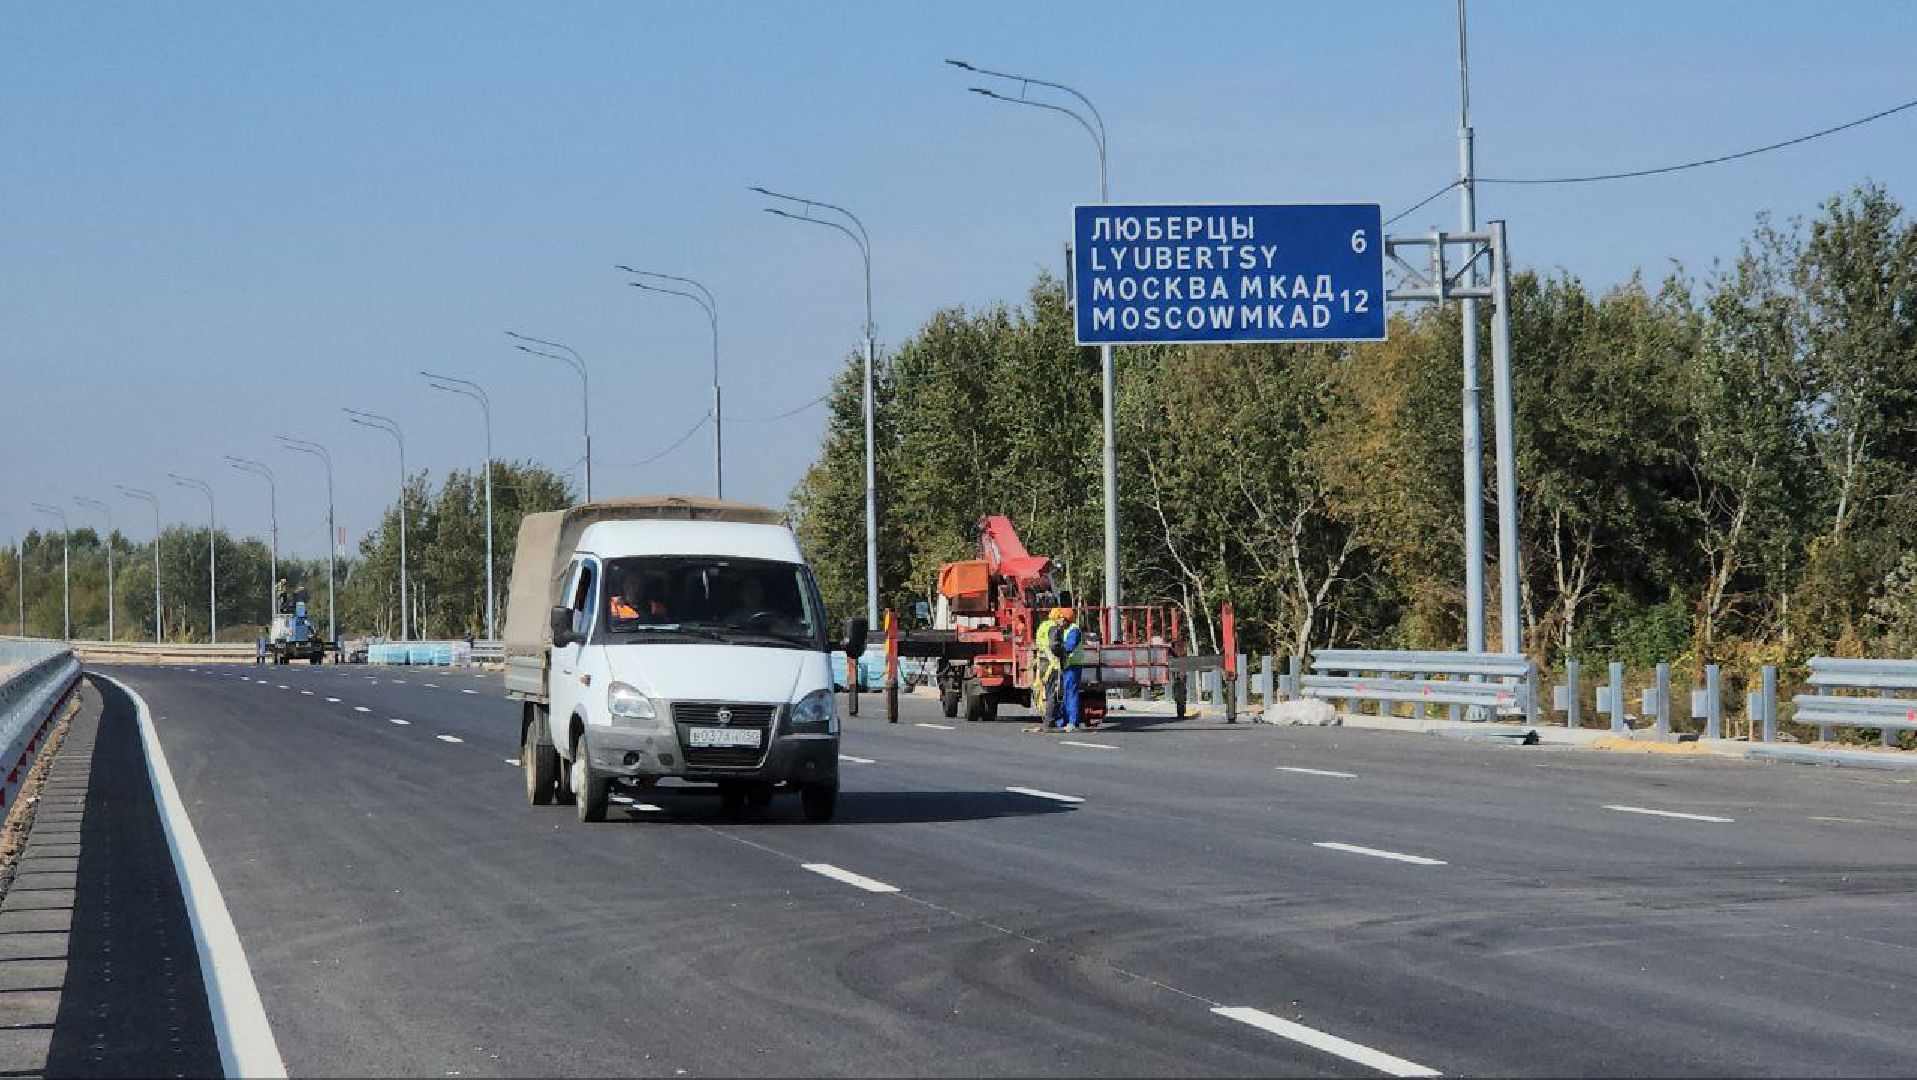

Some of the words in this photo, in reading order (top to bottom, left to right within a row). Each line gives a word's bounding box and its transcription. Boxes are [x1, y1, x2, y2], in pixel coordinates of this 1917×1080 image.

[1092, 217, 1254, 242] ЛЮБЕРЦЫ
[1351, 230, 1367, 253] 6
[1092, 246, 1277, 270] LYUBERTSY
[1093, 277, 1229, 300] МОСКВА
[1240, 275, 1334, 301] МКАД
[1341, 290, 1368, 313] 12
[1093, 307, 1234, 330] MOSCOW
[1241, 305, 1330, 329] MKAD
